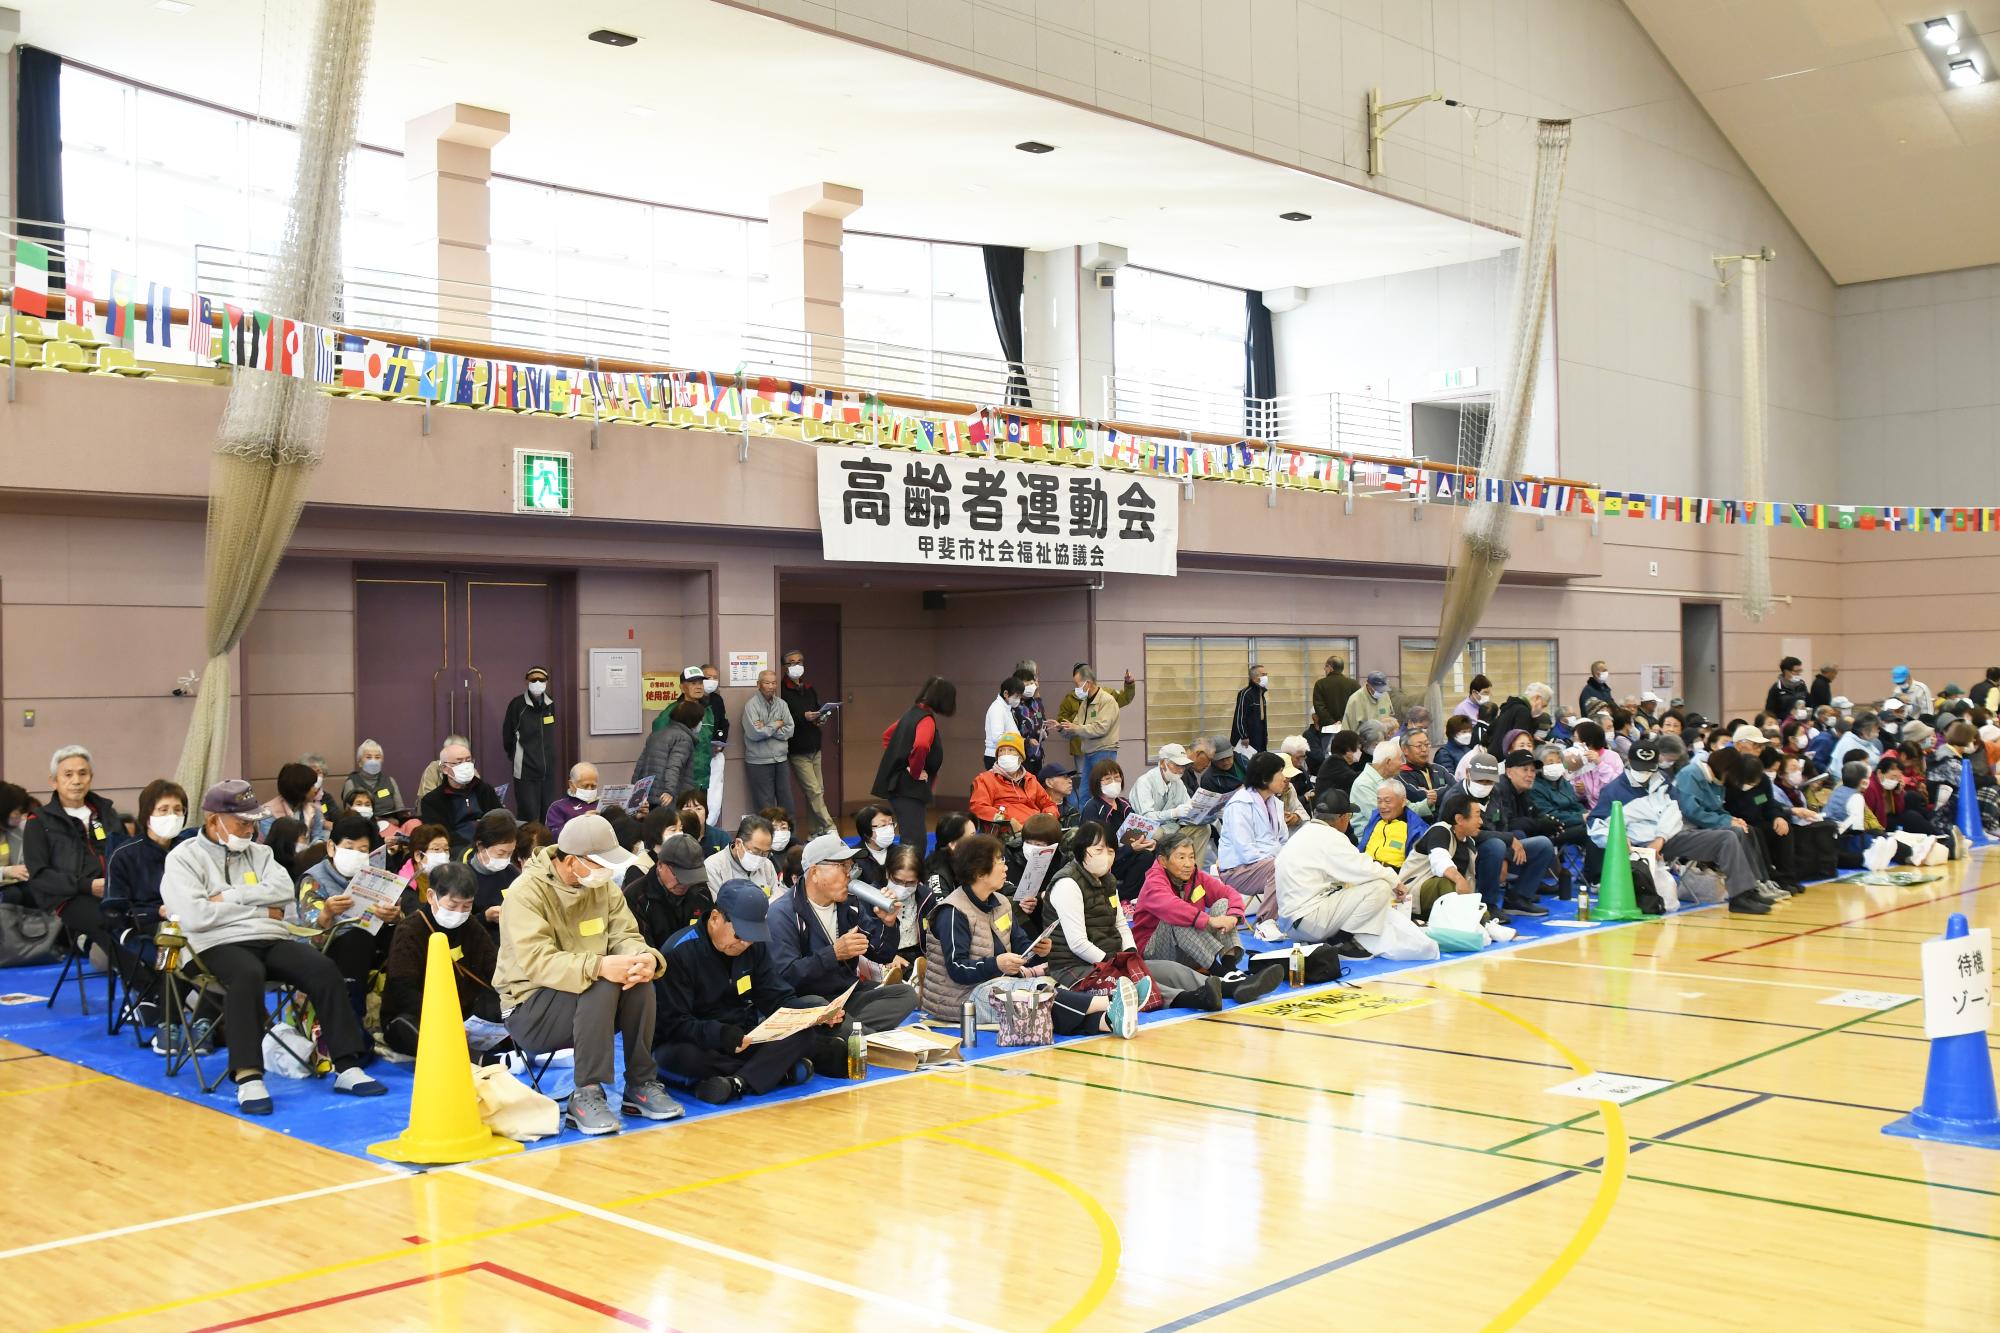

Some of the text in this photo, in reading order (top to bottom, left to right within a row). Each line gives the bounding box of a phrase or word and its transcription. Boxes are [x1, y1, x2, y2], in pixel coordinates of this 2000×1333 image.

[841, 457, 1155, 542] 高齢者運動会
[918, 536, 1104, 566] 甲斐市社会福祉協議会
[646, 691, 678, 701] 使用禁止
[1957, 949, 1984, 978] 待機
